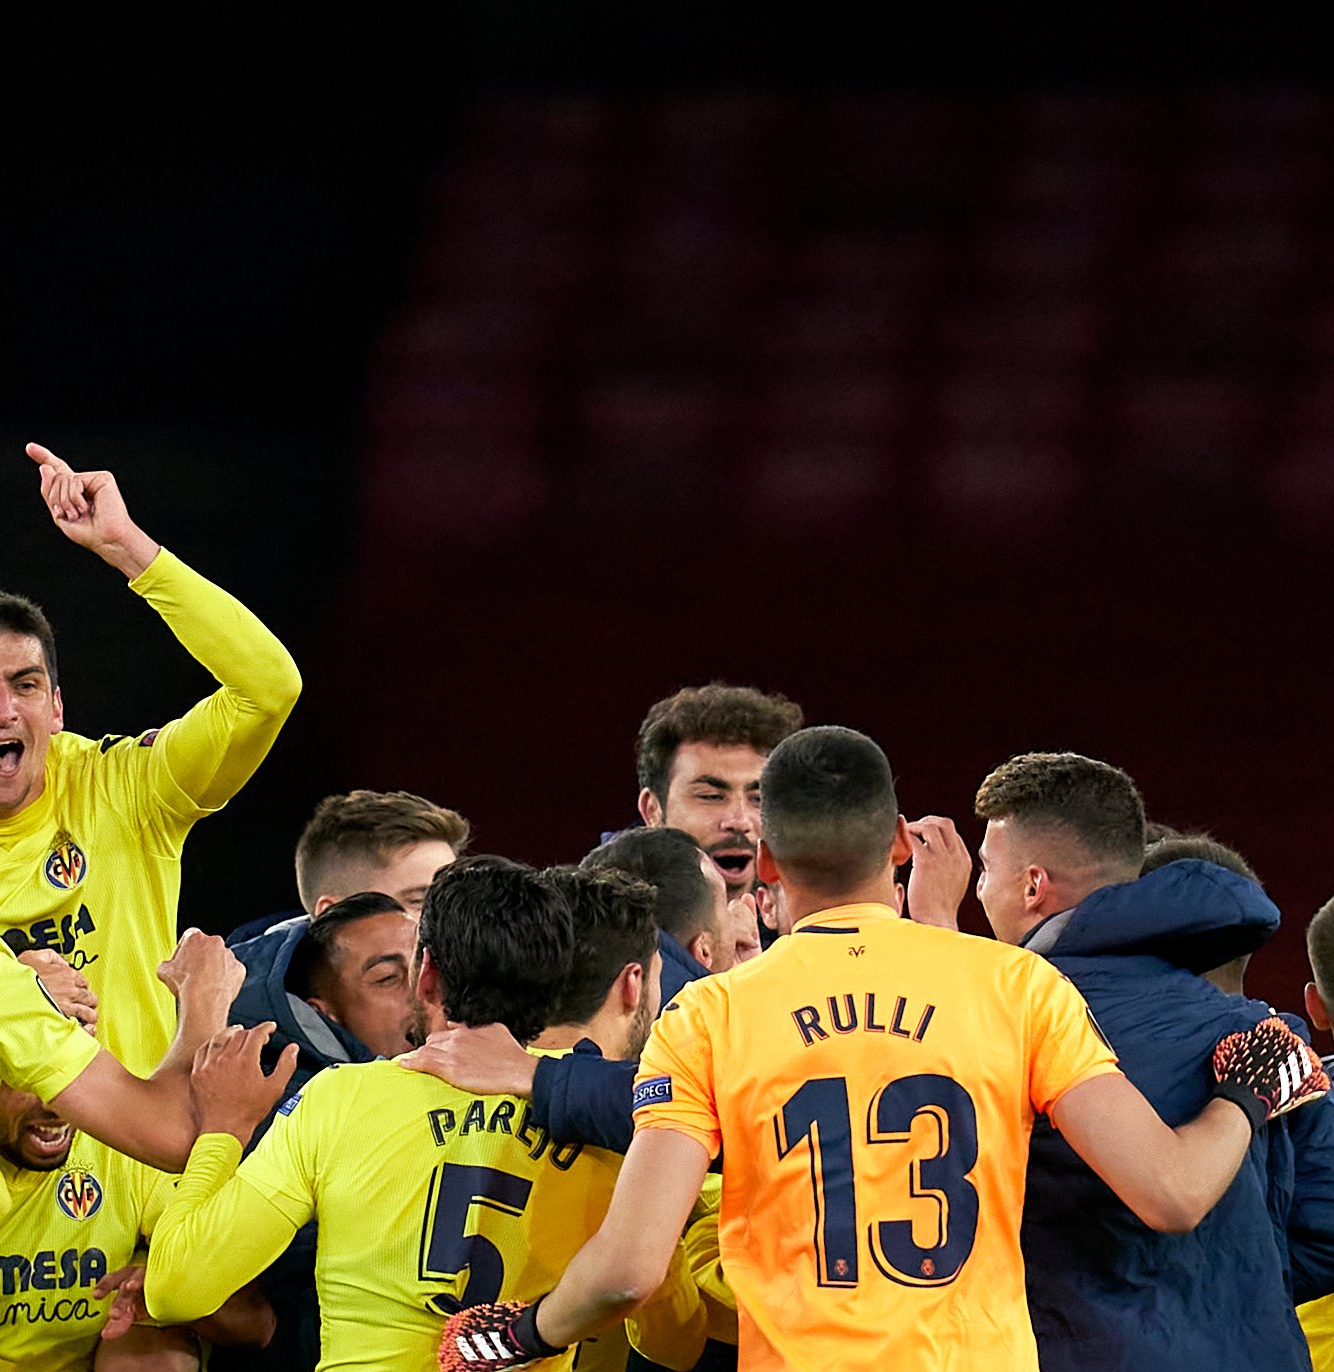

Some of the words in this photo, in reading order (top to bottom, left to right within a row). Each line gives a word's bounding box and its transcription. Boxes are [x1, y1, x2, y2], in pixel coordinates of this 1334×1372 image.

[791, 992, 935, 1047] RULLI
[634, 1083, 671, 1103] SPECT
[773, 1073, 980, 1288] 13
[419, 1162, 533, 1317] 5
